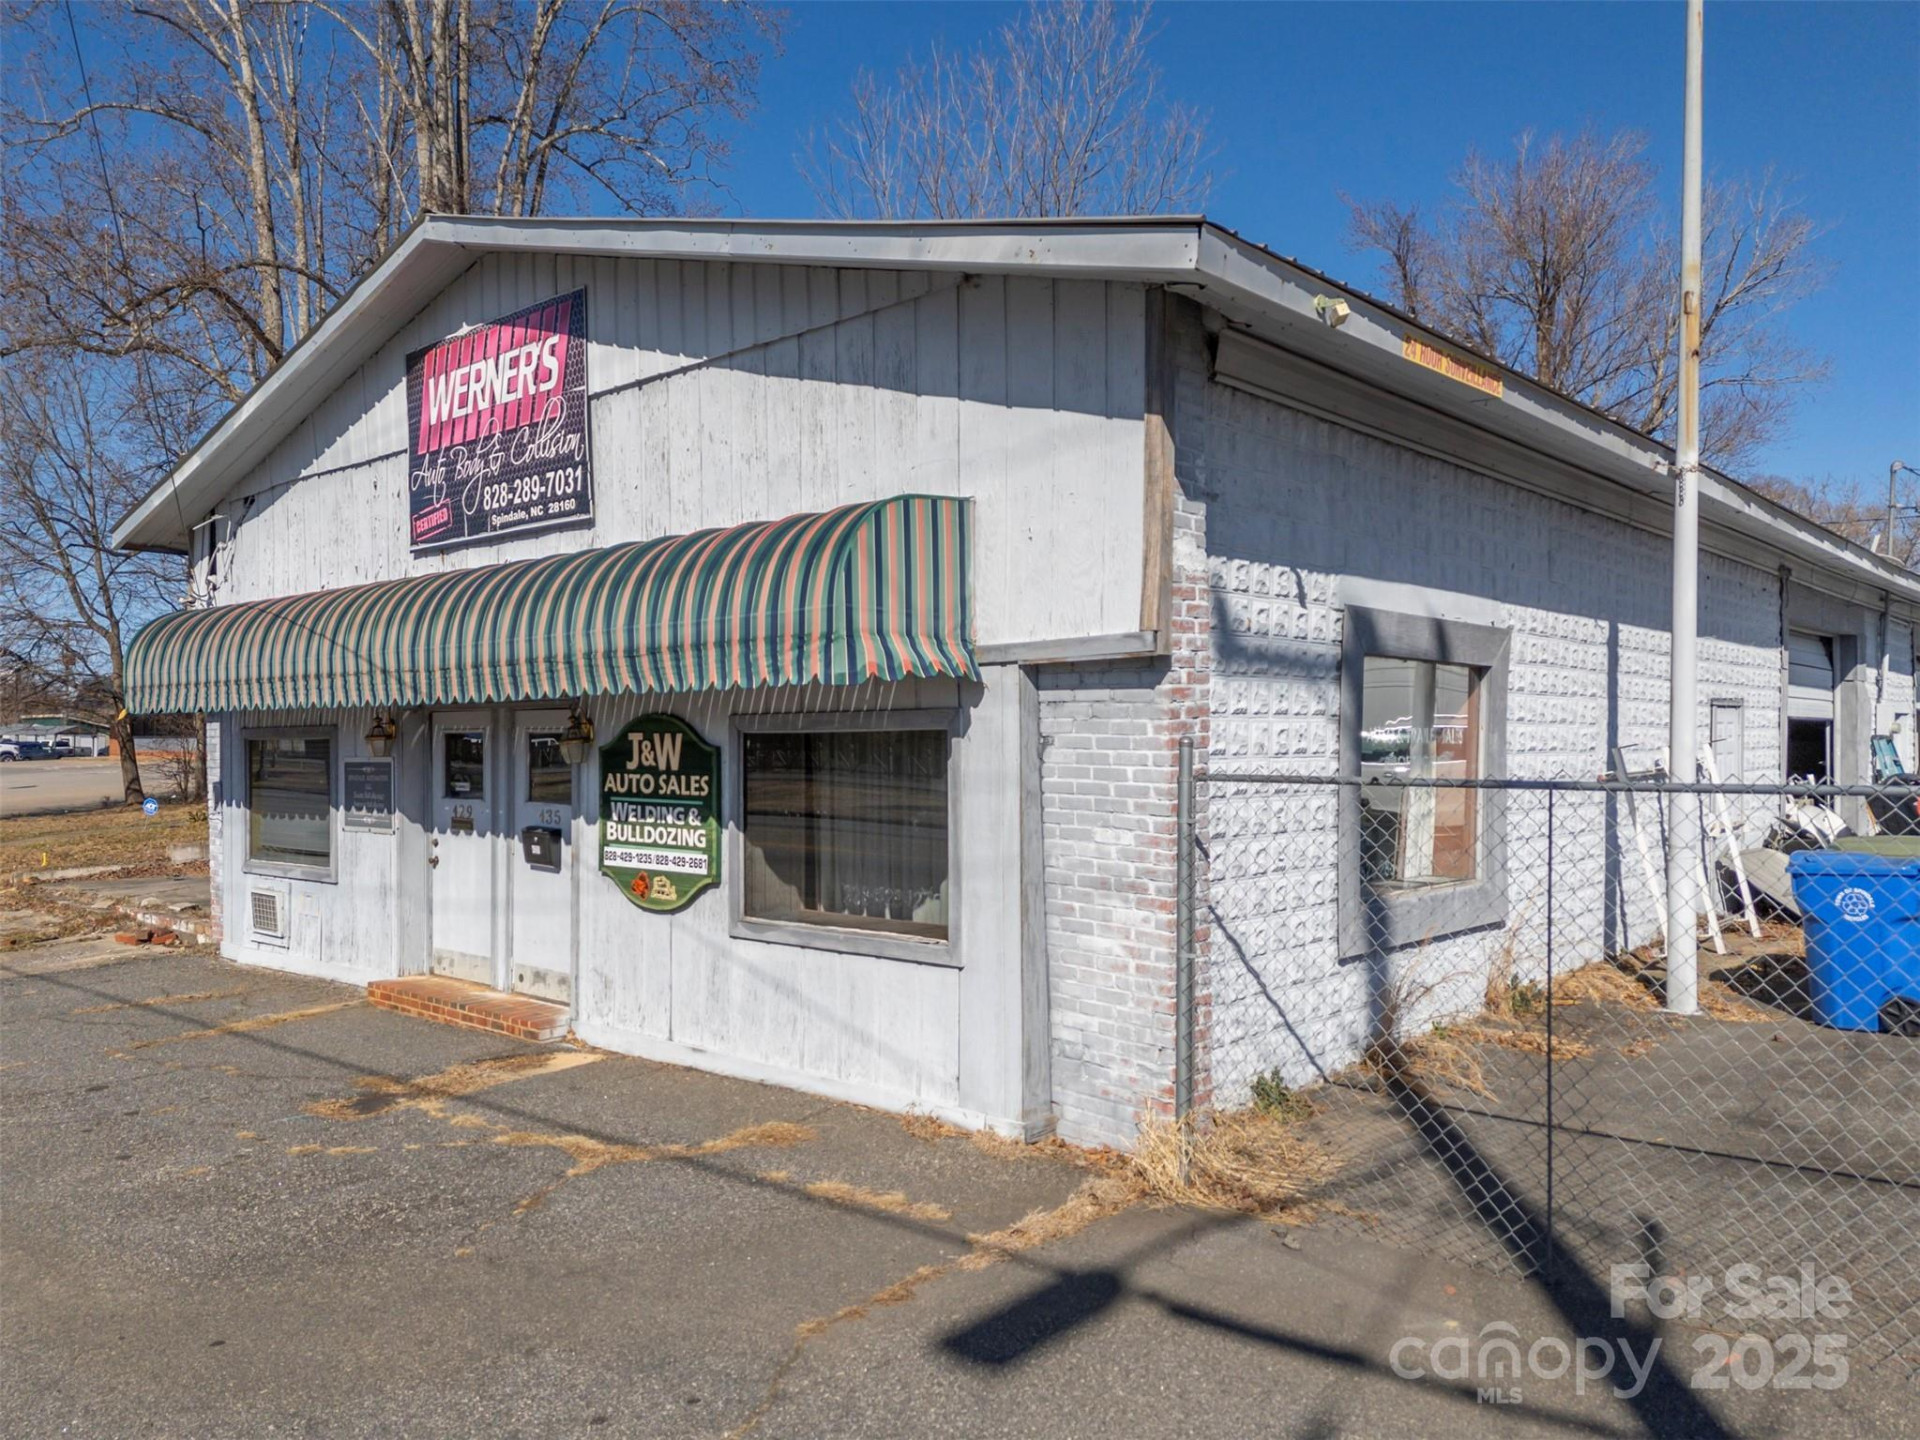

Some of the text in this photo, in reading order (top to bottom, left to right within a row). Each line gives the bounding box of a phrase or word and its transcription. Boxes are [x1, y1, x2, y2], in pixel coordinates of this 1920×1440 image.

[428, 334, 559, 426] WERNER'S
[411, 448, 447, 508] Auto
[512, 396, 584, 465] Collision
[483, 464, 582, 511] 828-289-7031
[416, 507, 448, 534] CERTIFIED
[491, 498, 576, 526] Spindale, NC 28160
[626, 732, 683, 771] J&W
[604, 773, 709, 797] AUTO SALES
[452, 804, 473, 819] 429
[539, 808, 561, 825] 435
[611, 801, 702, 826] WELDING &
[606, 821, 706, 848] BULLDOZING
